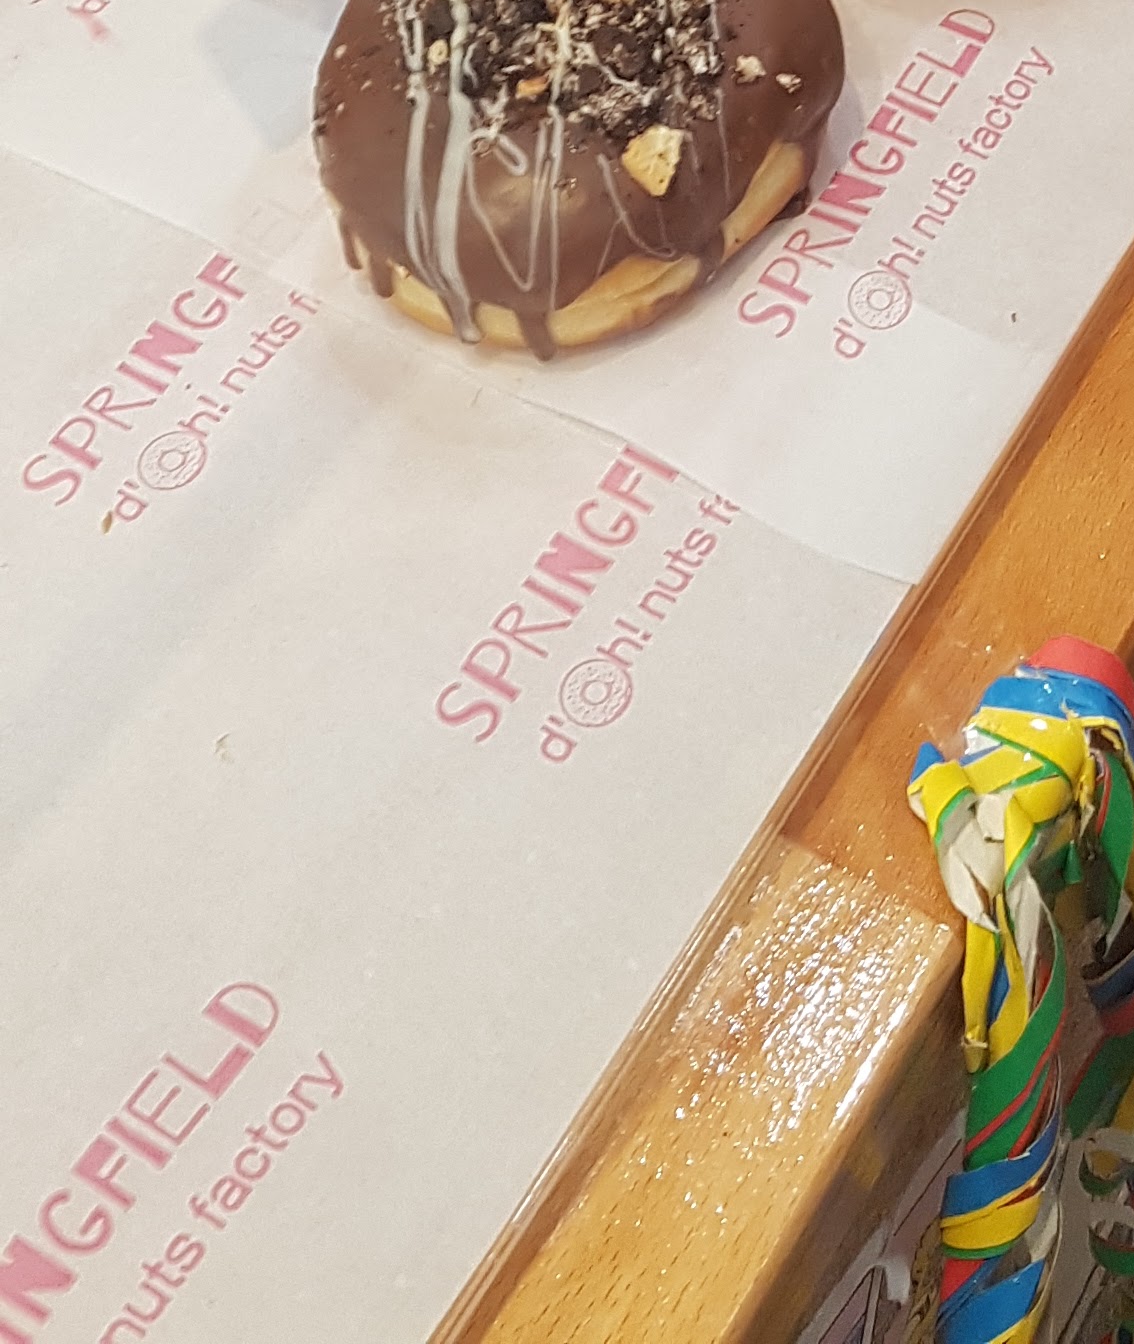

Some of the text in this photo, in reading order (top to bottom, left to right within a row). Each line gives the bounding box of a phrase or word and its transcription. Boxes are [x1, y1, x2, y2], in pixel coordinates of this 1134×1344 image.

[738, 8, 996, 339] SPRINGFIELD
[911, 161, 977, 240] nuts
[959, 45, 1055, 160] factory
[219, 313, 302, 394] nuts
[637, 527, 718, 623] nuts
[189, 1050, 345, 1230] factory
